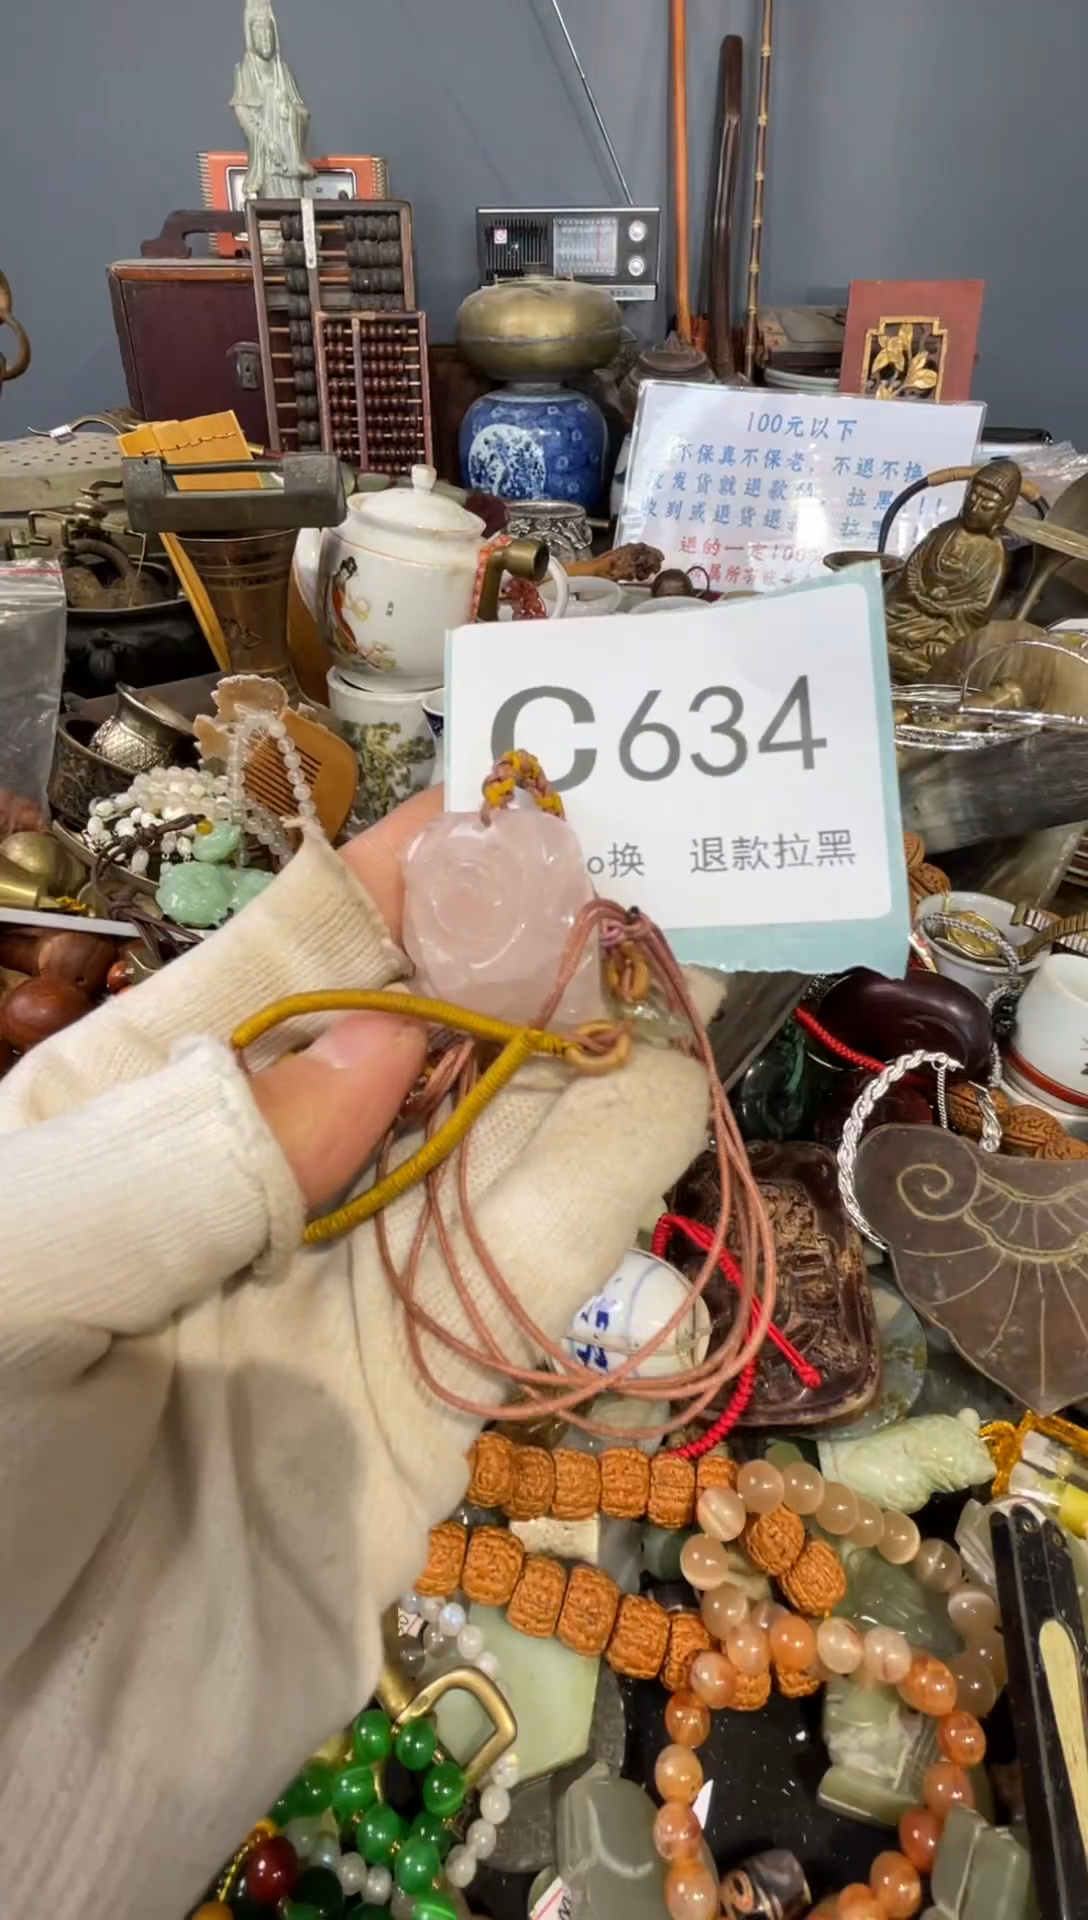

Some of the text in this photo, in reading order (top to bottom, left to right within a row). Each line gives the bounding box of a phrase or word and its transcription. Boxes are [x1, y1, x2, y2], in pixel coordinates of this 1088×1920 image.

[747, 411, 857, 441] 100元以下
[489, 674, 828, 795] C634
[690, 829, 857, 873] 退款拉黑
